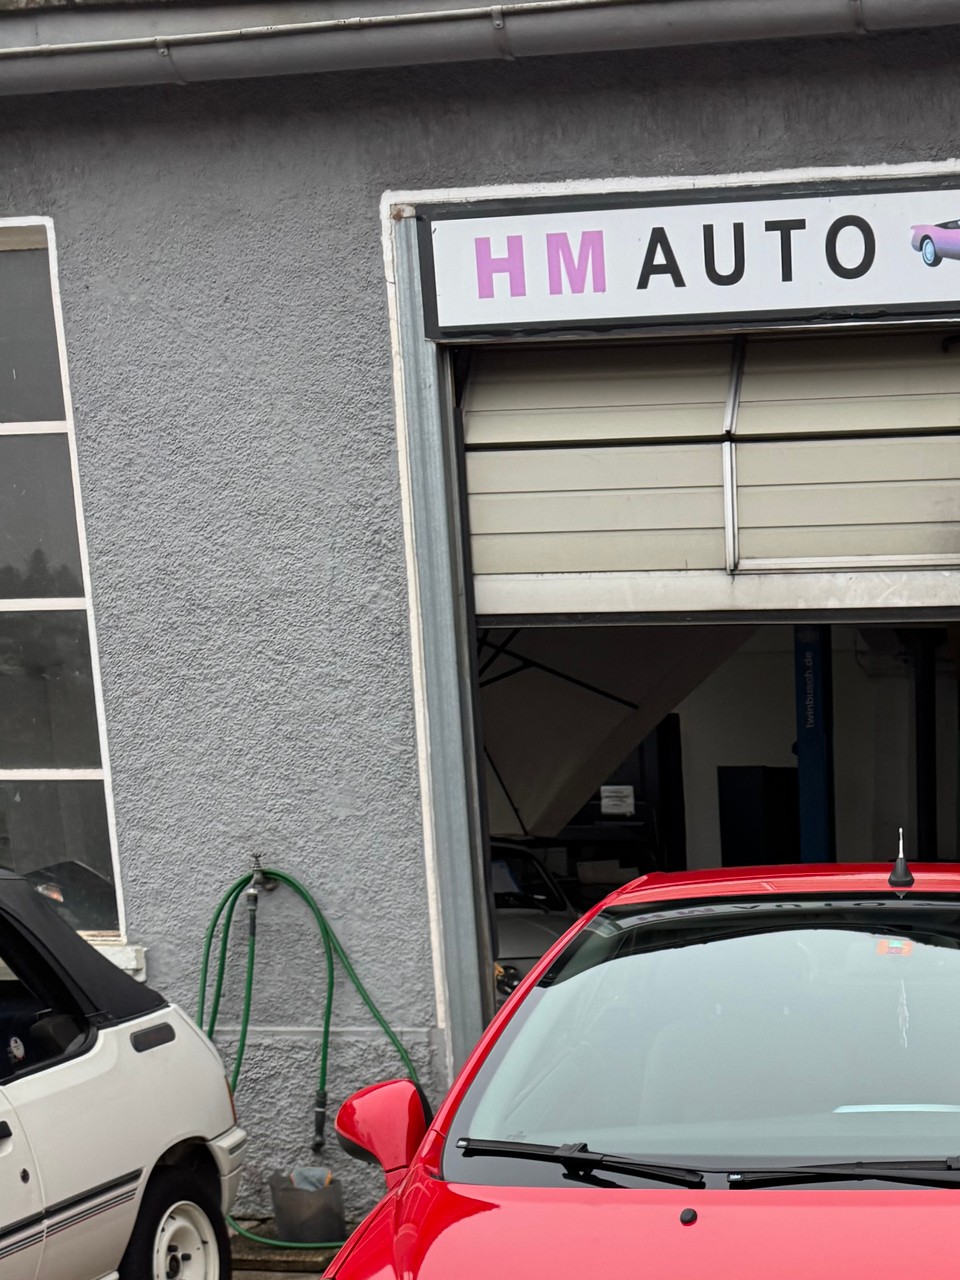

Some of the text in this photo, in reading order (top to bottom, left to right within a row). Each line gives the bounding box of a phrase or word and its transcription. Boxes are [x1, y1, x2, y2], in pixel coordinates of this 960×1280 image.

[475, 215, 877, 300] HM AUTO
[803, 651, 815, 729] twinbusch.de
